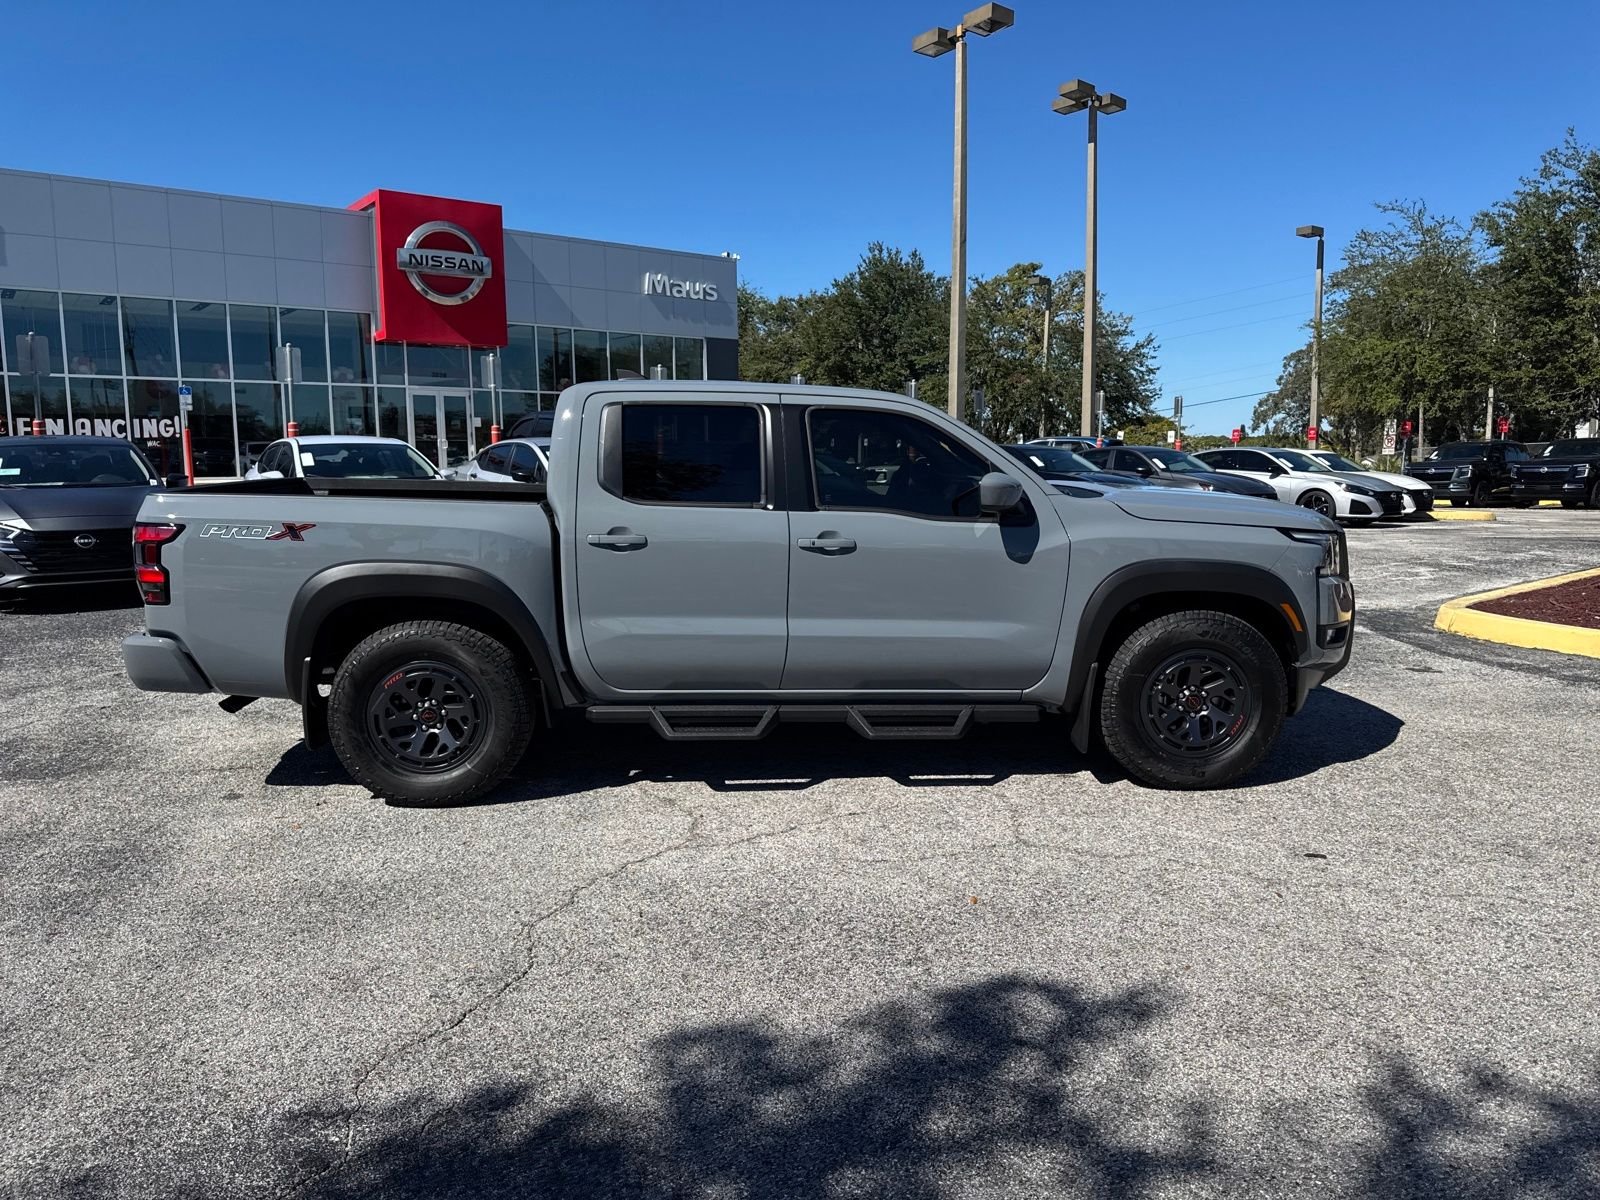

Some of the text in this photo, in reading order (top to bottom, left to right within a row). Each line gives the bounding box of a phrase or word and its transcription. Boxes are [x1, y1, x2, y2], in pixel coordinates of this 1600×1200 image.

[408, 253, 484, 273] NISSAN
[644, 272, 718, 301] Maus
[16, 415, 181, 438] FNANCING!
